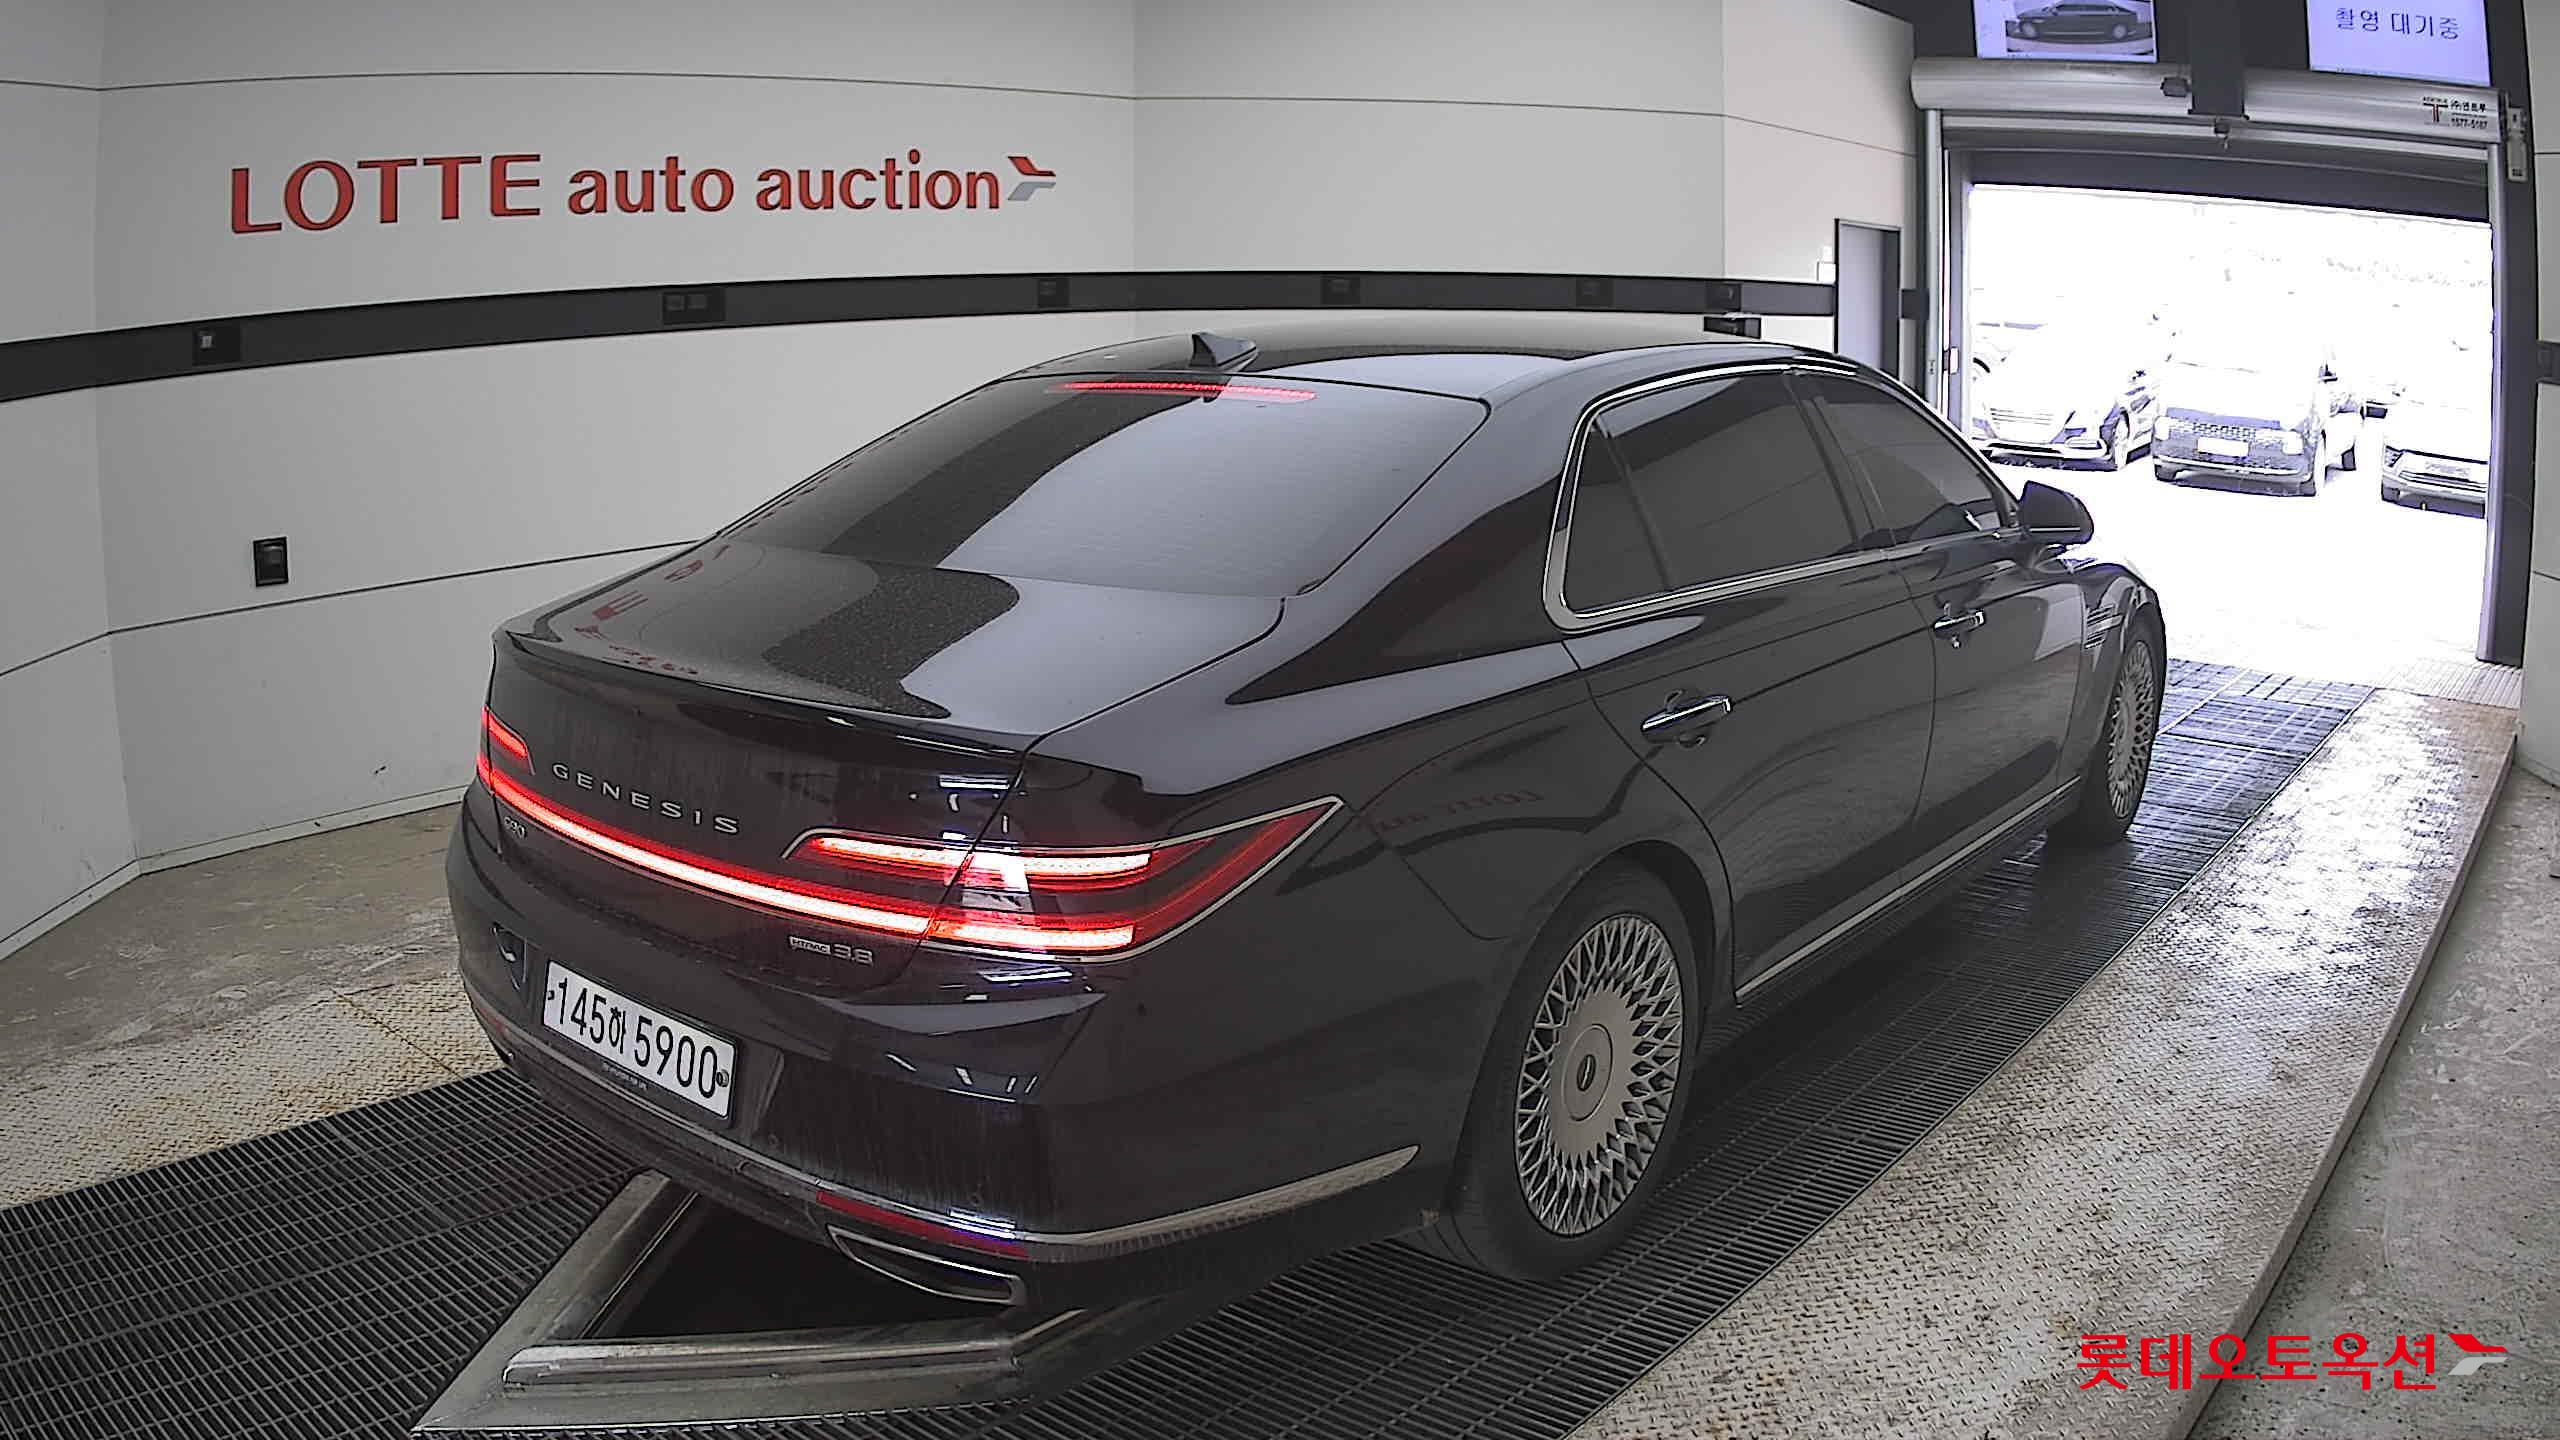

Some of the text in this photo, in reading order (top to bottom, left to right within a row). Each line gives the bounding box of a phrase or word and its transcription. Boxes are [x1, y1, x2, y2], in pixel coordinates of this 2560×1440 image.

[2335, 7, 2459, 39] 촬영 대기중
[231, 150, 1001, 234] LOTTE auto auction
[552, 764, 739, 834] GENESIS
[833, 943, 874, 967] 3.8
[558, 977, 719, 1099] 145하 5900
